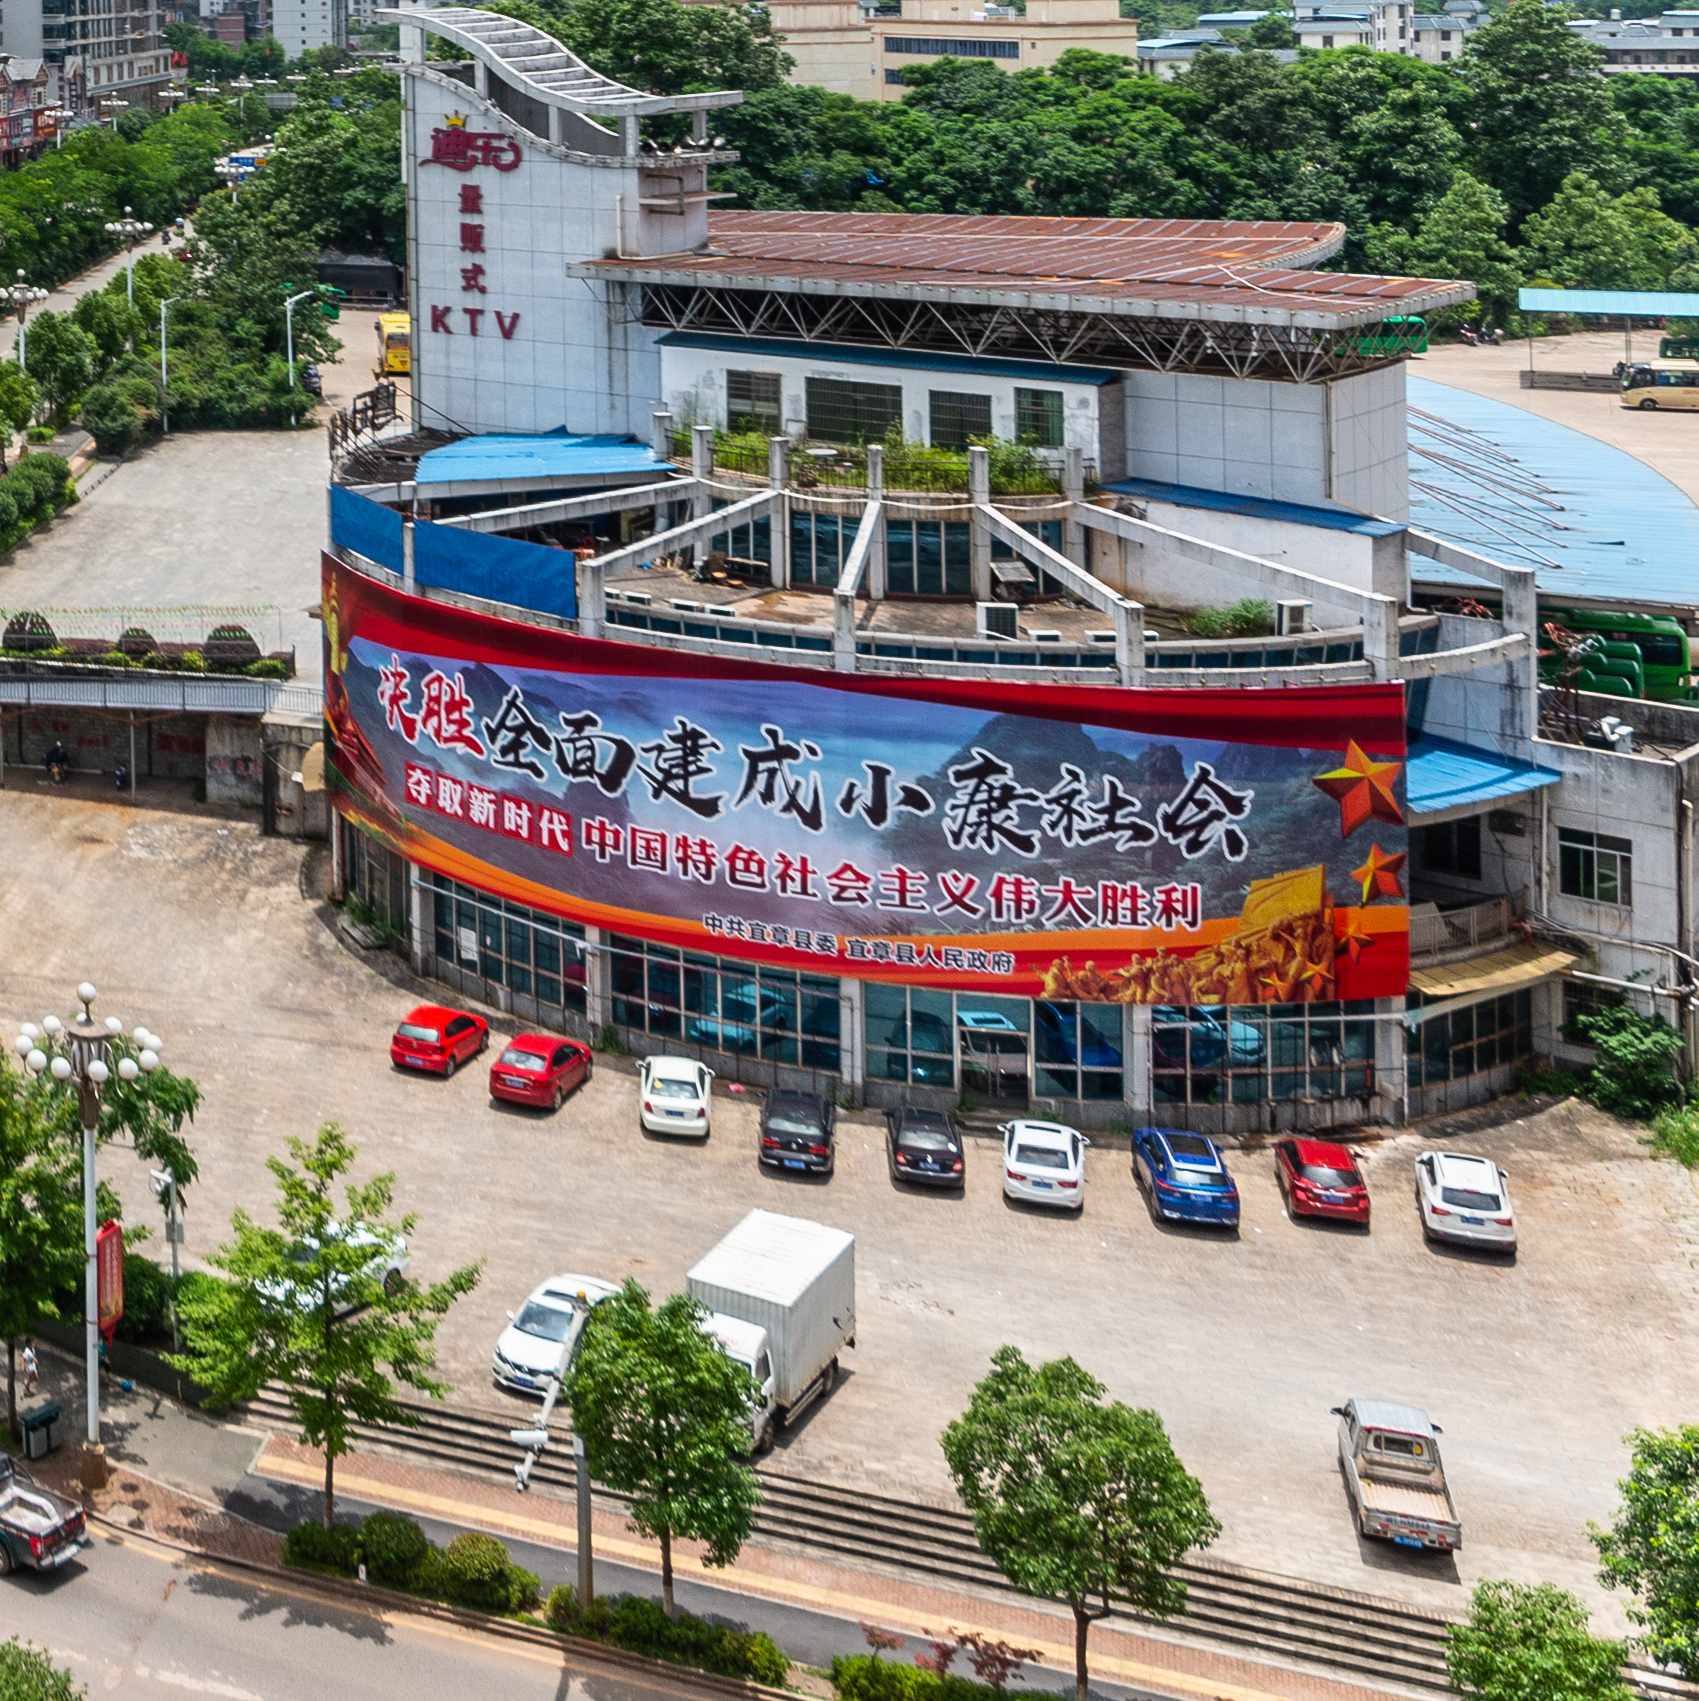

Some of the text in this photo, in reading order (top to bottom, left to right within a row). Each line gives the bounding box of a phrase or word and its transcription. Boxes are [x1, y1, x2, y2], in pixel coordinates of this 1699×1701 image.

[458, 184, 486, 294] 量贩式
[431, 304, 520, 339] KTV
[377, 653, 1253, 861] 决胜全面建成小康社会
[405, 763, 1202, 931] 夺取新时代 中国特色社会主义伟大胜利
[702, 912, 1015, 975] 中共宜章县委 宜章县人民政府
